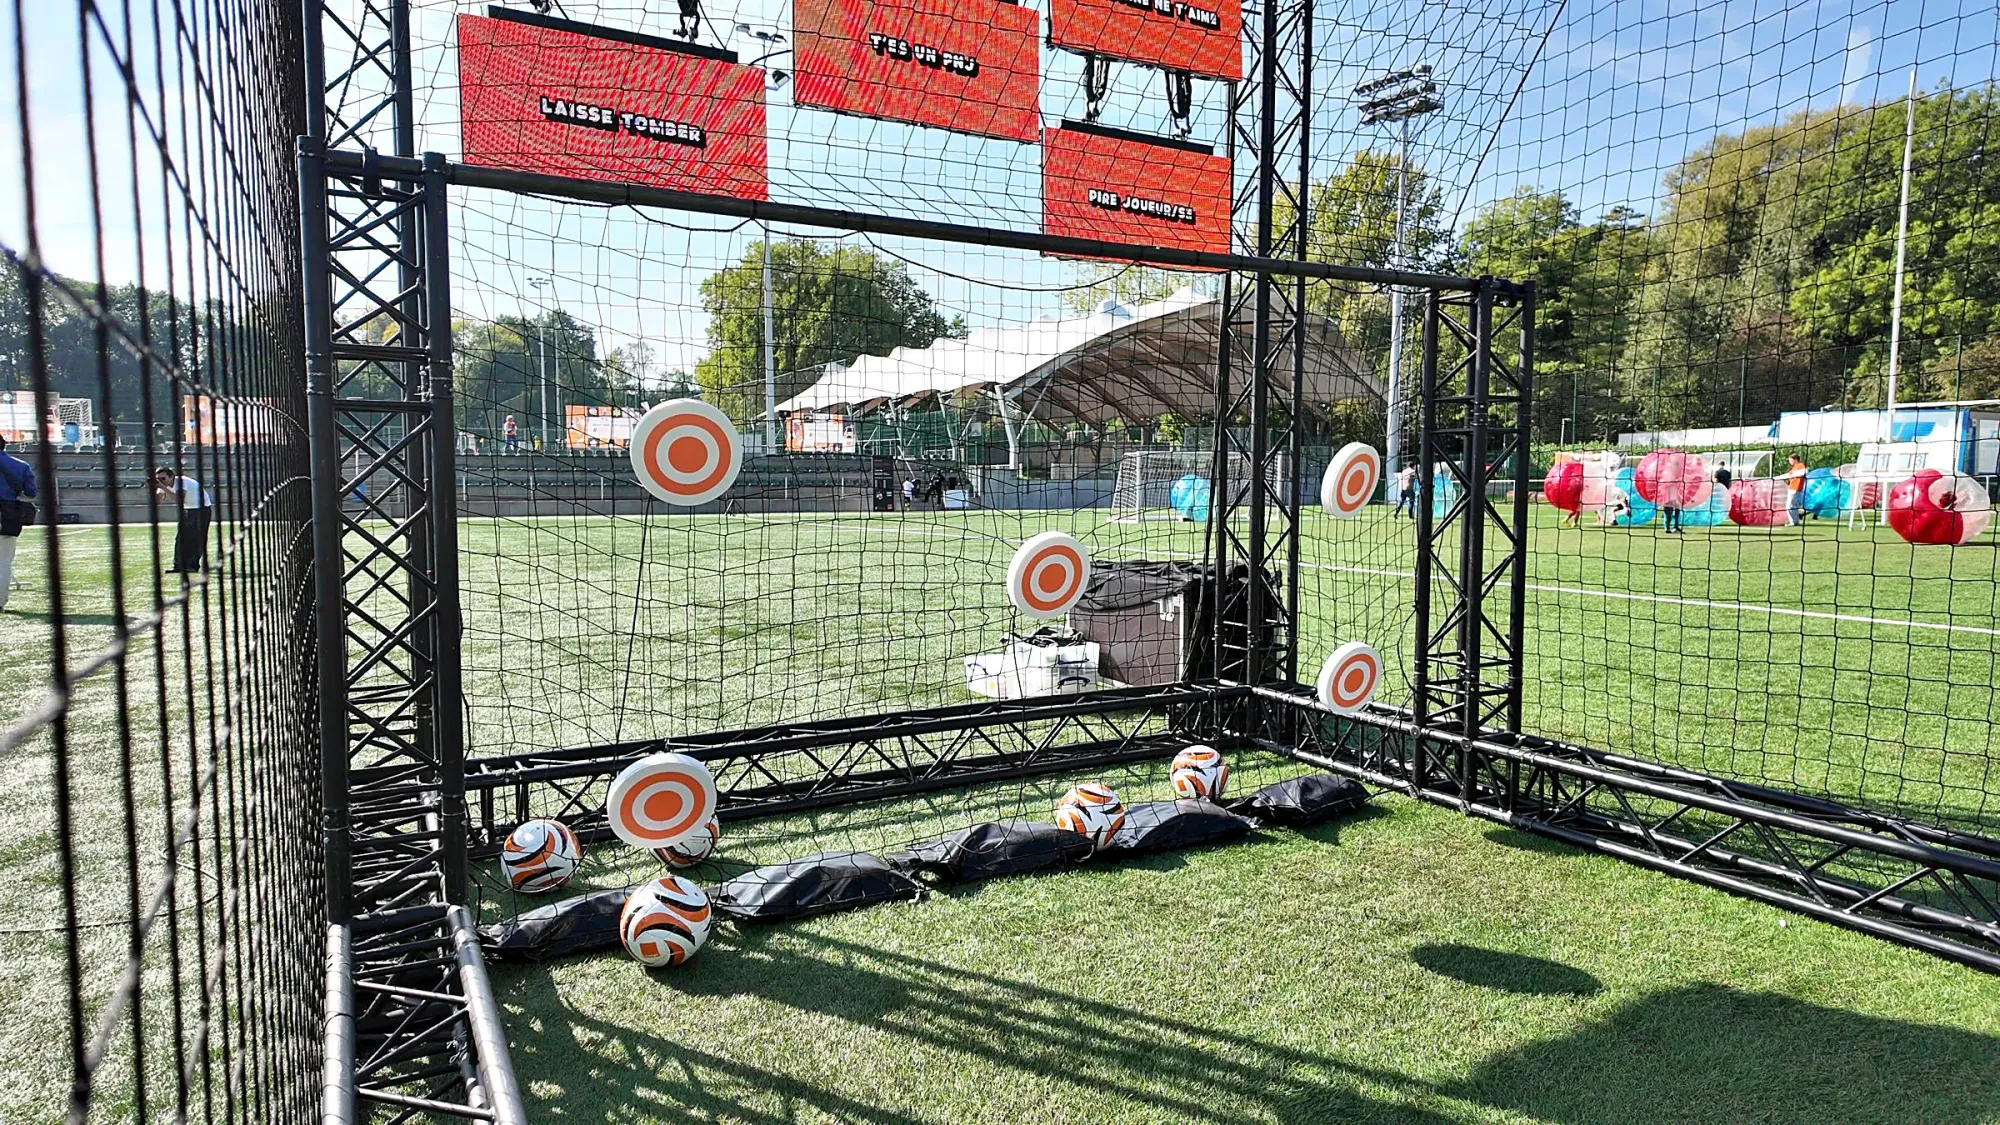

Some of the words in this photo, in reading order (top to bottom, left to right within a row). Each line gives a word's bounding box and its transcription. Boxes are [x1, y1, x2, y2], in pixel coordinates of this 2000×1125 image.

[1154, 0, 1171, 13] NE
[1175, 3, 1218, 27] T'AIME
[870, 34, 910, 58] T'ES
[913, 44, 939, 65] UN
[942, 51, 977, 74] PNJ
[540, 96, 615, 127] LAISSE
[620, 112, 703, 145] TOMBER
[1088, 188, 1118, 207] PIRE
[1122, 195, 1194, 221] JOUEUR/SE
